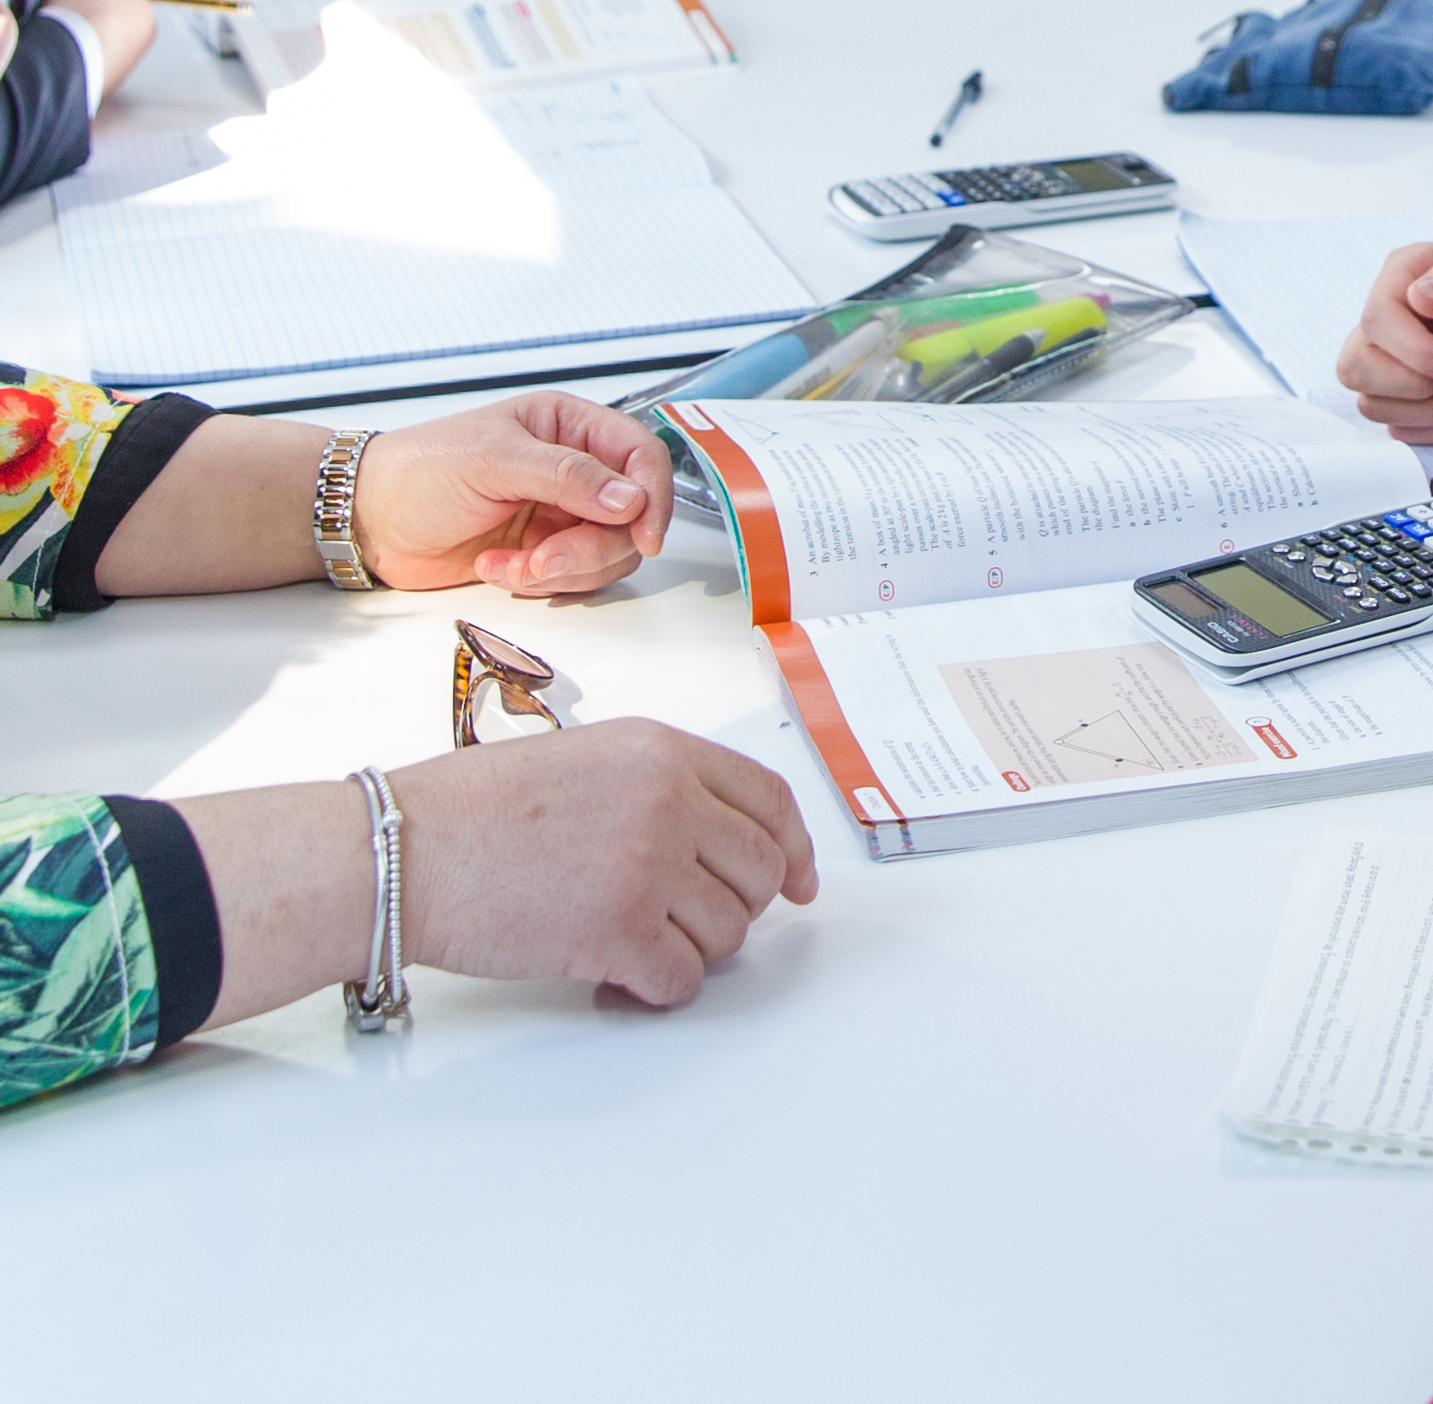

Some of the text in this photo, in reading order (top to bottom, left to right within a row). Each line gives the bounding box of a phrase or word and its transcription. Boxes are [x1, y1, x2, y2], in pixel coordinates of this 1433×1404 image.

[1119, 484, 1130, 502] force
[1131, 477, 1145, 500] normal
[1151, 486, 1164, 505] plane
[1210, 479, 1224, 507] smooth
[1269, 470, 1288, 509] the vertical
[1291, 477, 1301, 497] Show
[1029, 489, 1044, 519] attached
[1055, 495, 1066, 506] the
[1072, 488, 1088, 514] particle
[1106, 495, 1115, 507] the
[1239, 490, 1249, 504] and
[1267, 494, 1276, 511] The
[797, 510, 807, 518] of
[868, 501, 878, 517] mass
[1043, 488, 1060, 536] which passes
[1058, 508, 1069, 517] of
[1125, 504, 1134, 516] the
[1139, 502, 1149, 514] the
[1159, 507, 1167, 523] The
[826, 514, 835, 522] as
[871, 520, 881, 528] of
[895, 498, 914, 553] light scale-pan
[923, 498, 940, 550] The scale-pan
[948, 498, 966, 547] force exerted
[980, 504, 996, 533] particle
[1012, 507, 1026, 540] with the
[1082, 516, 1091, 532] The
[1093, 518, 1103, 531] the
[1109, 509, 1120, 529] Find
[1389, 513, 1407, 521] AC
[802, 520, 815, 549] acrobat
[808, 500, 830, 563] By modelling the
[835, 497, 857, 560] the tension in the
[911, 508, 928, 552] passes over
[996, 511, 1008, 542] smooth
[1062, 519, 1074, 535] end
[1412, 523, 1429, 533] DEL
[830, 524, 844, 561] tightrope
[874, 531, 885, 545] box
[887, 527, 900, 555] angled
[944, 539, 953, 548] of
[809, 551, 817, 564] An
[879, 548, 887, 556] A
[1207, 621, 1239, 643] CASIO
[1261, 727, 1281, 744] exercise
[1273, 743, 1292, 757] Mixed
[1008, 773, 1027, 790] Challenge
[1361, 865, 1379, 898] American
